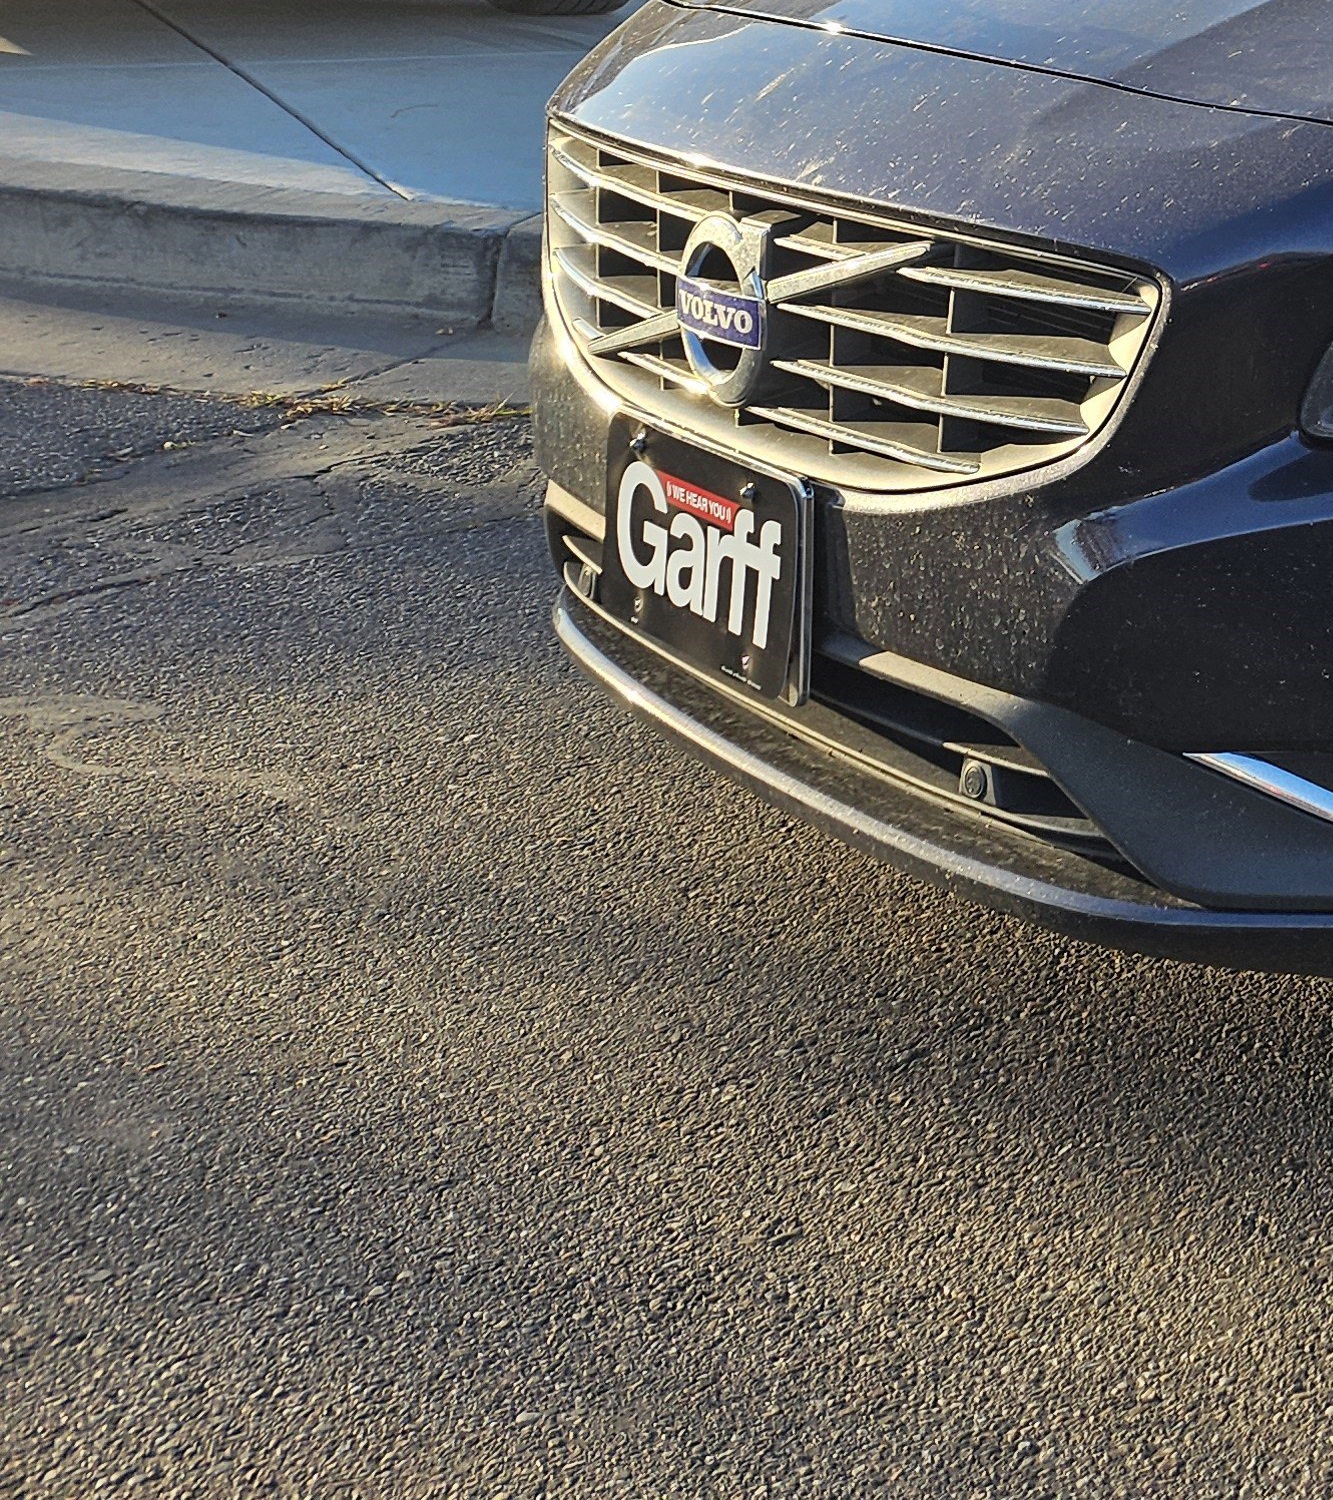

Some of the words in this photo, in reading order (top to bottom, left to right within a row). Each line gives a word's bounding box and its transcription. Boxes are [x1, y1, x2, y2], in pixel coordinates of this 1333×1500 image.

[679, 288, 753, 334] VOLVO
[672, 484, 686, 503] WE
[686, 490, 709, 513] HEAR
[708, 500, 726, 521] YOU
[616, 460, 782, 650] Garff
